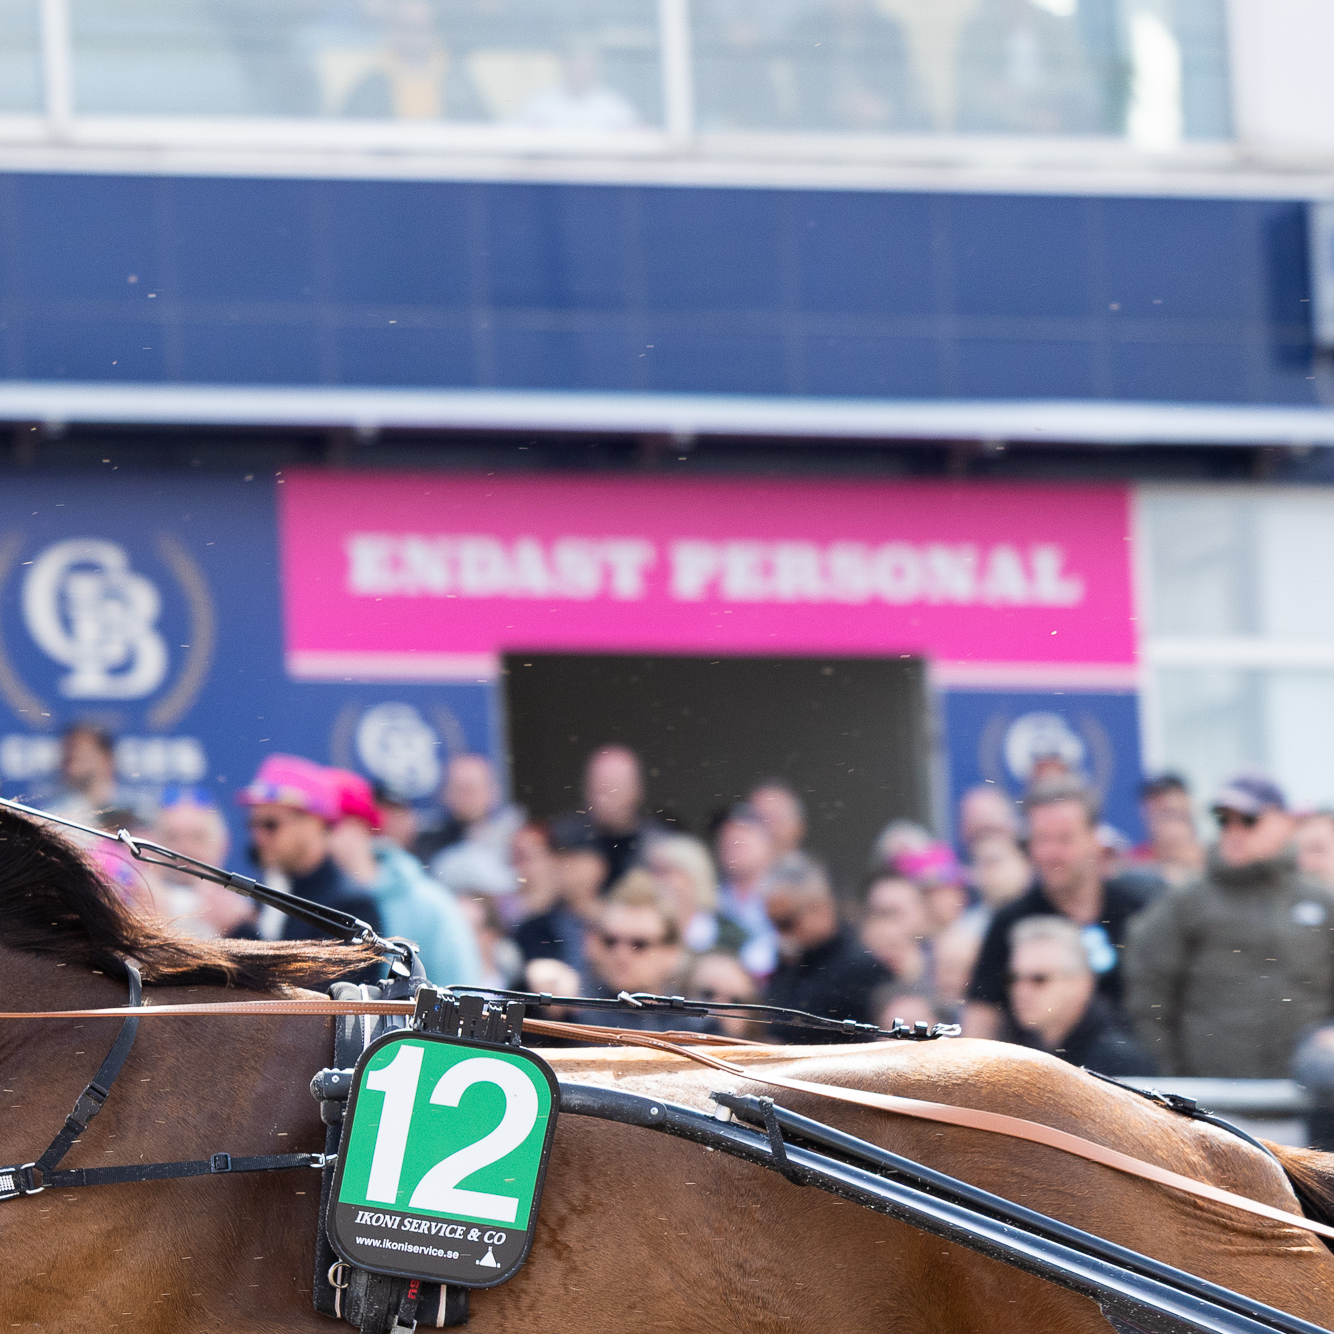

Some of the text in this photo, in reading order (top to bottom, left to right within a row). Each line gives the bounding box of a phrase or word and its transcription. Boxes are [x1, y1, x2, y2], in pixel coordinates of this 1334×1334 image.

[345, 533, 1084, 608] ENDAST PERSONAL
[365, 1044, 539, 1224] 12
[354, 1210, 507, 1246] IKONI SERVICE & CO
[355, 1235, 460, 1260] www.ikoniservice.se
